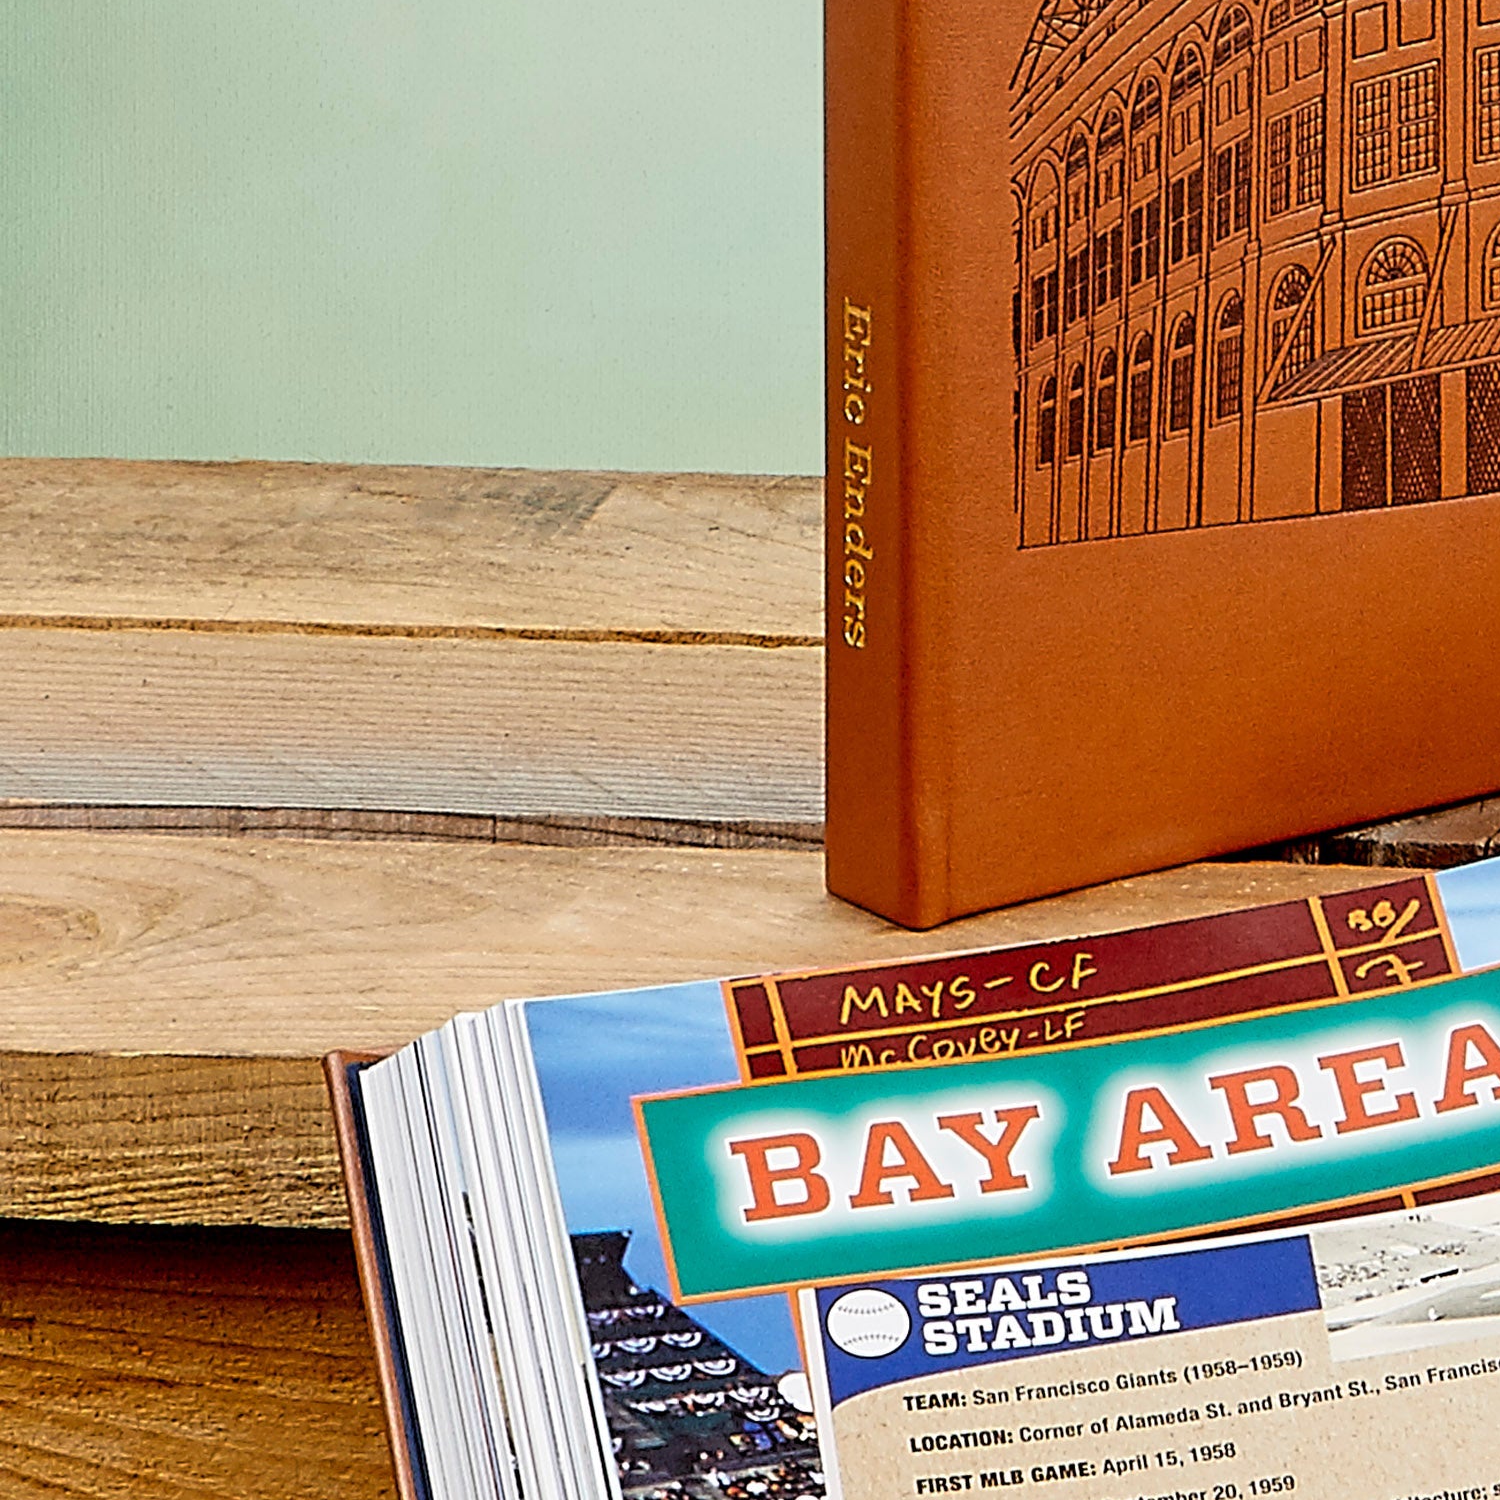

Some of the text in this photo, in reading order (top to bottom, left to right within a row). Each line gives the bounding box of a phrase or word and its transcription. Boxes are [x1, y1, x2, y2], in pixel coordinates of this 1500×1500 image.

[843, 295, 874, 650] Eric Enders
[726, 1102, 1044, 1224] BAY
[915, 1270, 1093, 1320] SEALS
[922, 1296, 1182, 1358] STADIUM
[902, 1391, 967, 1412] TEAM:
[972, 1389, 1010, 1406] San
[1014, 1379, 1110, 1402] Francisco
[1115, 1369, 1178, 1390] Giants
[909, 1429, 1014, 1453] LOCATION:
[1019, 1423, 1084, 1443] Corner
[1090, 1417, 1109, 1435] of
[1115, 1407, 1200, 1432] Alameda
[1205, 1402, 1232, 1420] St.
[1237, 1395, 1273, 1415] and
[1278, 1384, 1344, 1409] Bryant
[1347, 1380, 1381, 1398] St.,
[1384, 1374, 1422, 1391] San
[915, 1442, 1237, 1495] FIRST MLB GAME: April 15, 1958
[1248, 1475, 1295, 1496] 1959
